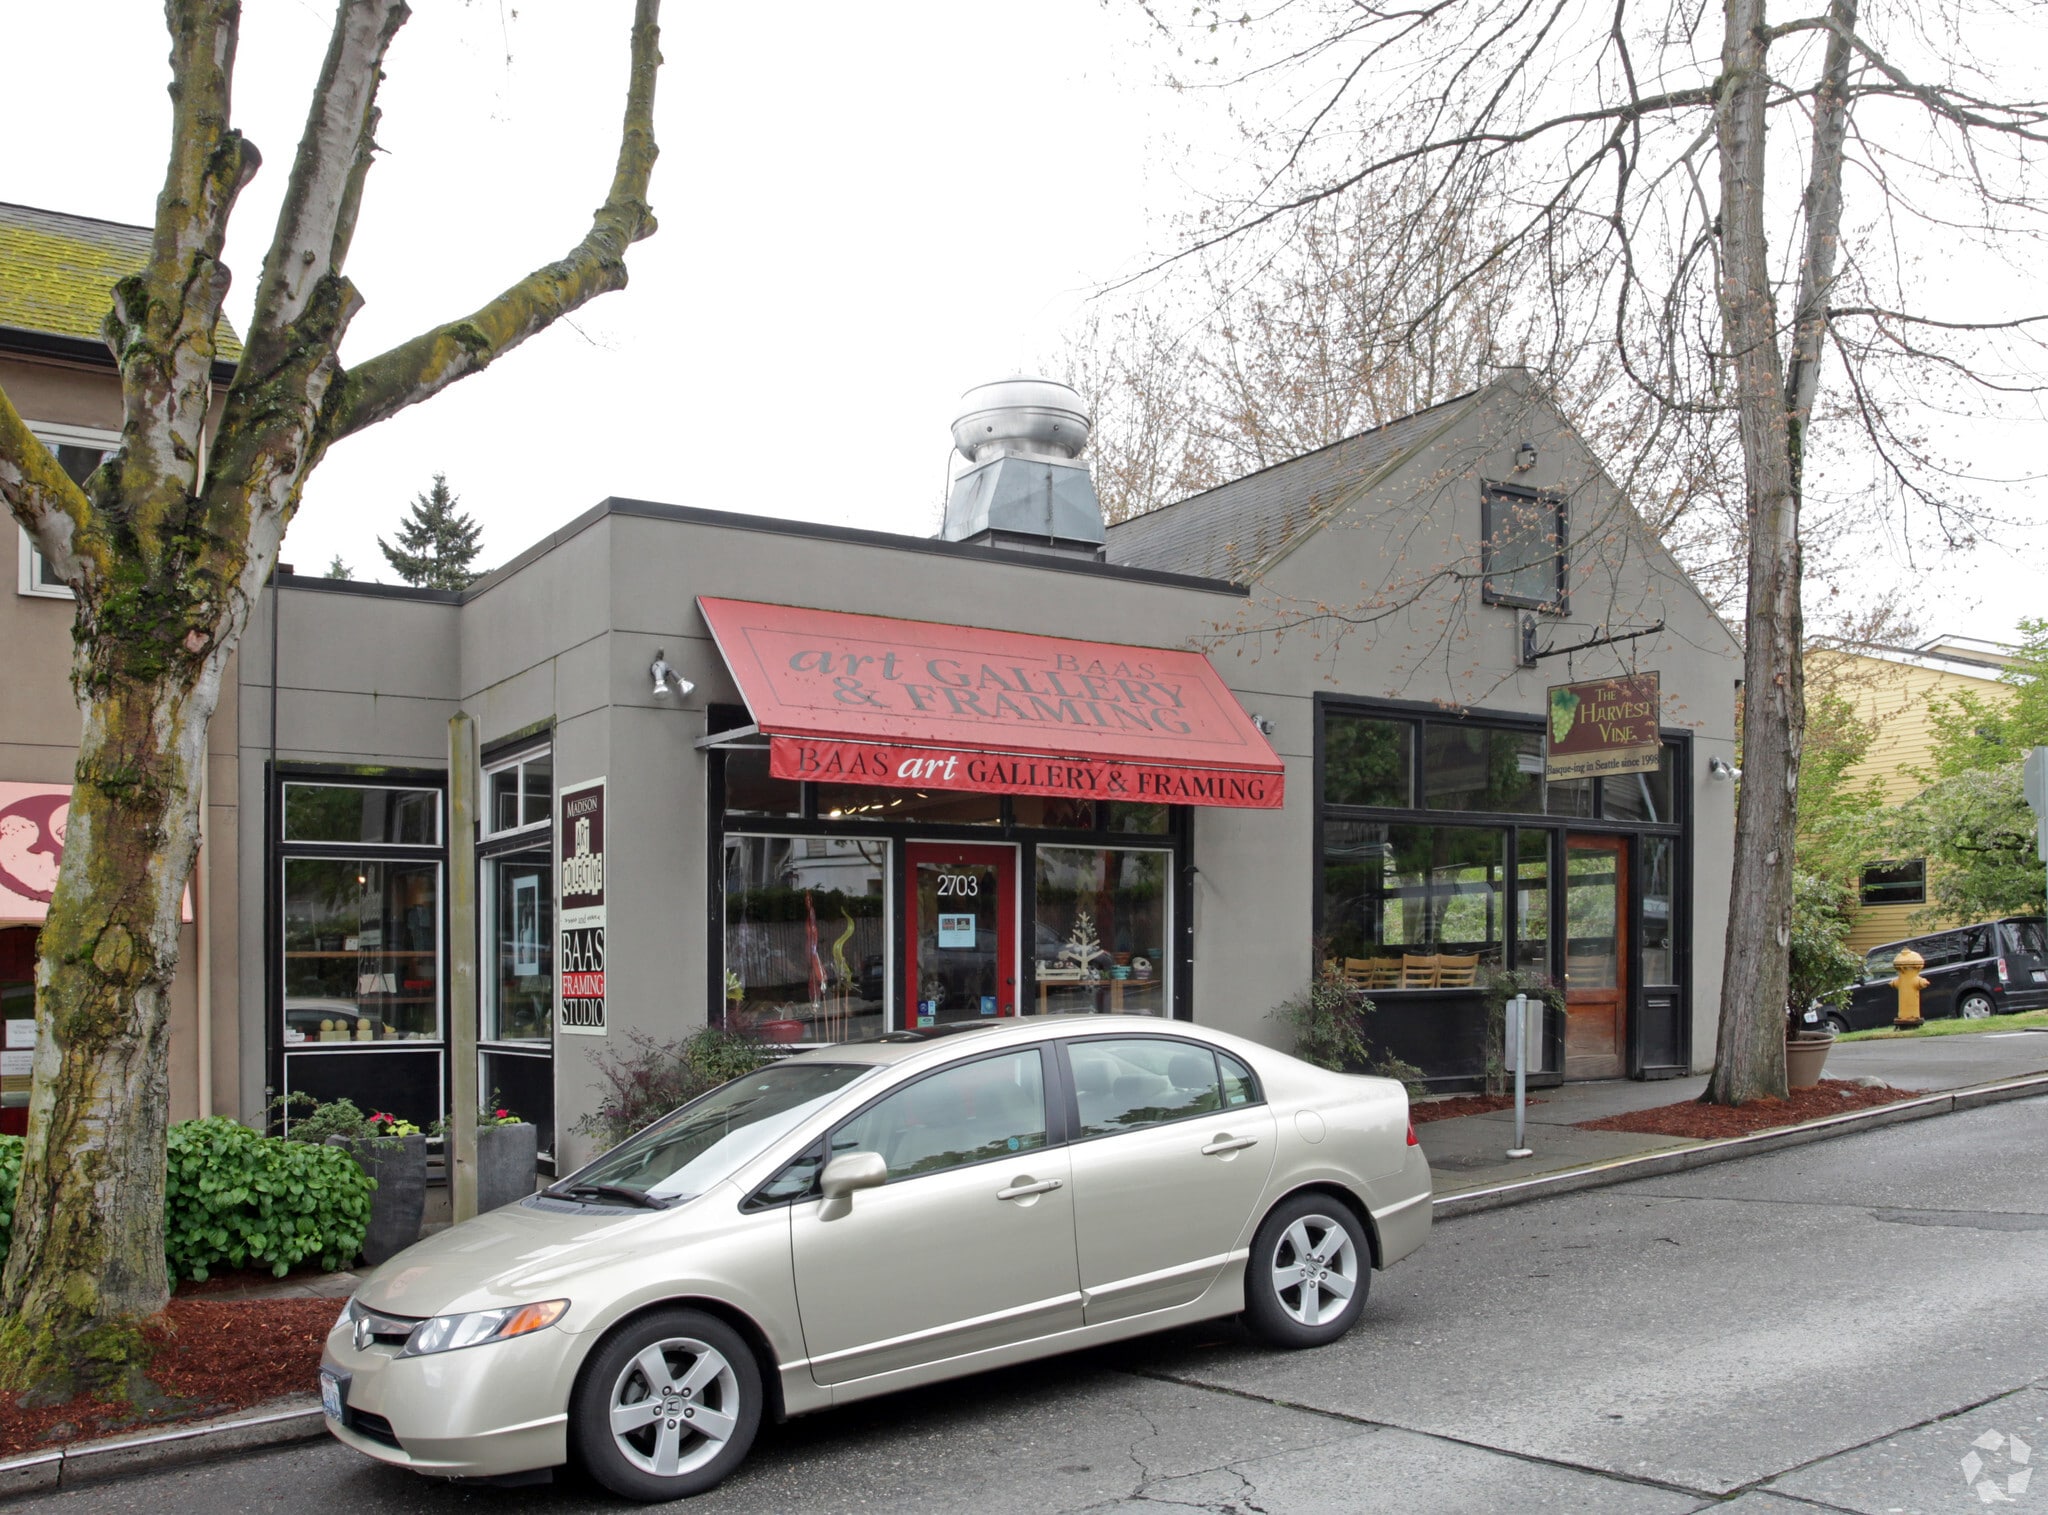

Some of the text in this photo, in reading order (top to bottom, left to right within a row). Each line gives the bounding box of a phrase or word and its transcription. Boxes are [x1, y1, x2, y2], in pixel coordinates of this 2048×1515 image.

[788, 650, 1186, 708] art GALLERY
[1055, 653, 1156, 680] BAAS
[832, 676, 1192, 734] & FRAMING
[1595, 689, 1616, 701] THE
[1581, 702, 1650, 724] HARVEST
[1599, 723, 1633, 742] VINE
[799, 747, 1265, 801] BAAS art GALLERY & FRAMING
[1586, 761, 1594, 771] in
[1595, 758, 1620, 770] Seattle
[1621, 757, 1640, 767] since
[567, 797, 597, 817] MADISON
[576, 822, 589, 850] ART
[563, 858, 601, 890] COLLECTIVE
[937, 874, 978, 896] 2703
[562, 929, 604, 972] BAAS
[562, 974, 604, 995] FRAMING
[562, 998, 604, 1026] STUDIO
